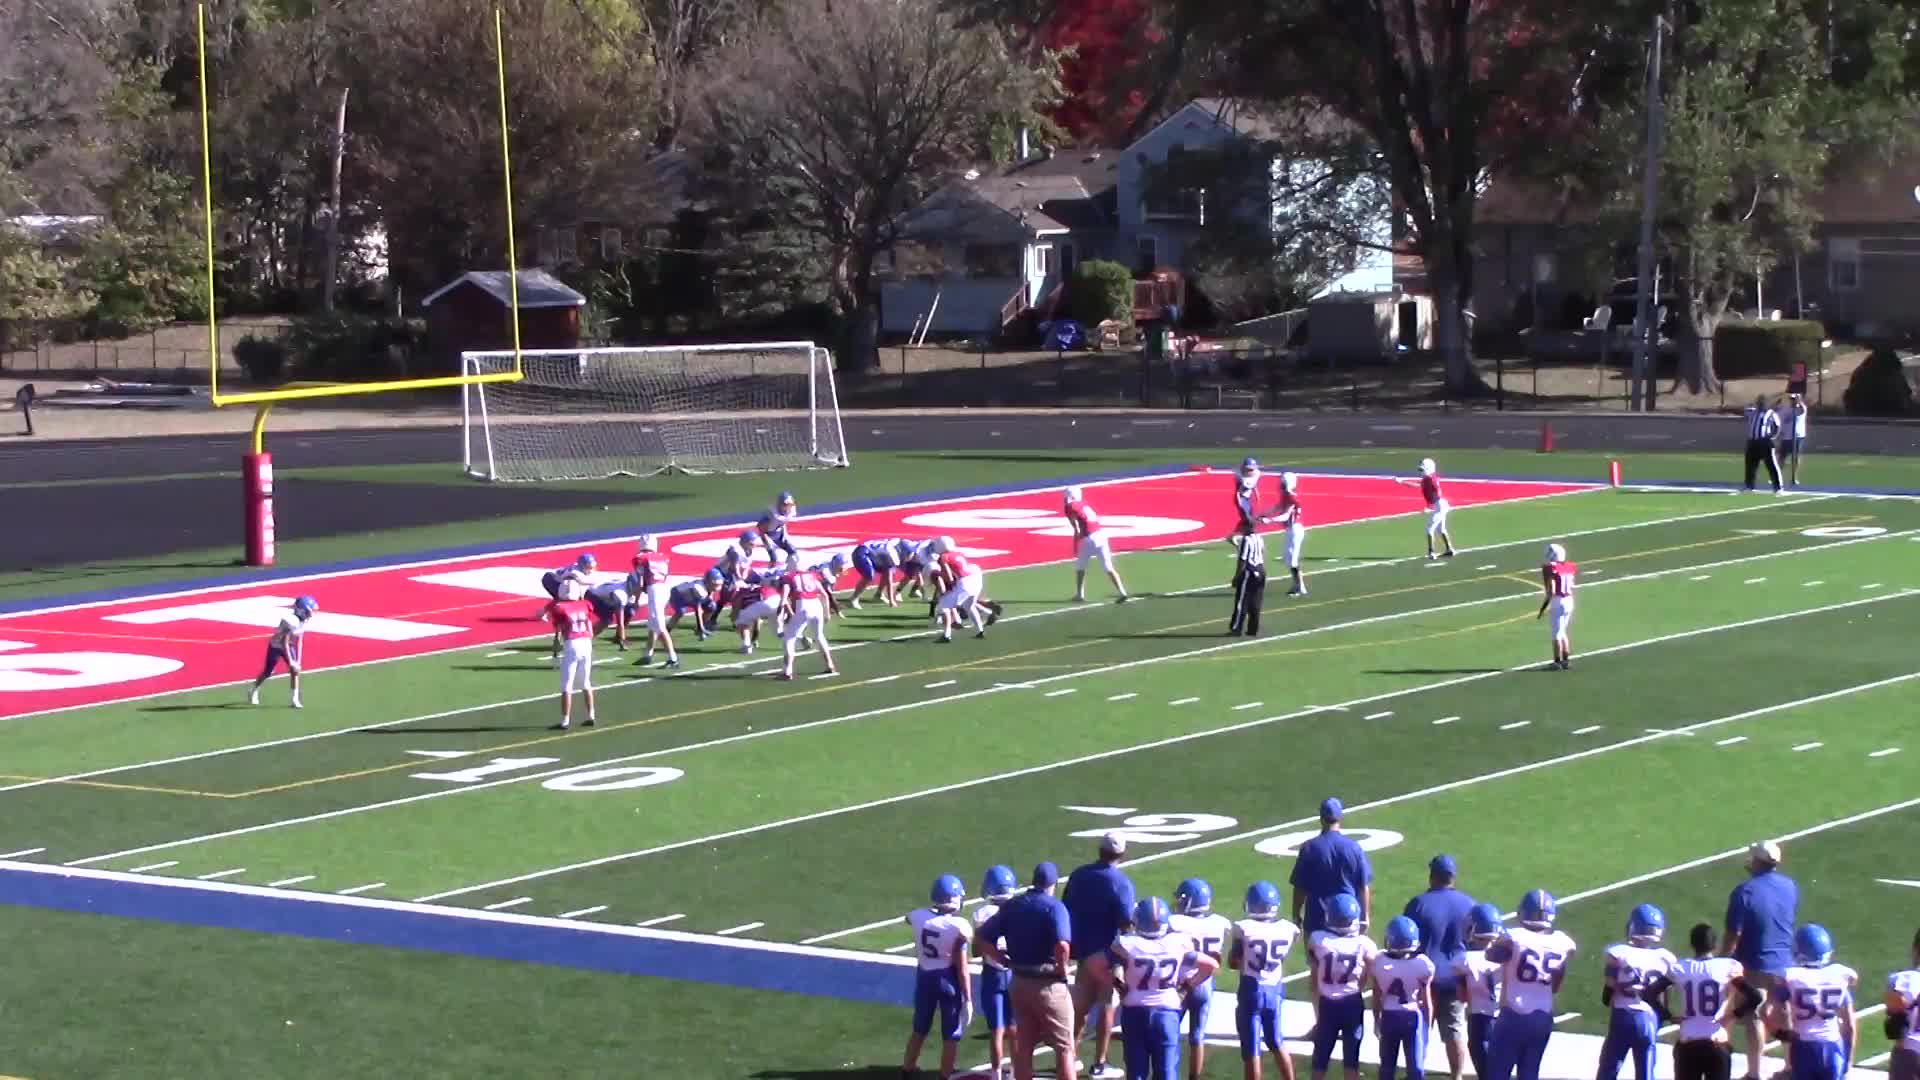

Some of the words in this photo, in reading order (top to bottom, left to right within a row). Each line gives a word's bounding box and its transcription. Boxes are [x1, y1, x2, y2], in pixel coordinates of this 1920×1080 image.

[407, 756, 685, 792] 10
[921, 928, 940, 959] 5
[1247, 939, 1289, 974] 35
[1134, 958, 1178, 990] 72
[1322, 952, 1358, 985] 17
[1516, 948, 1562, 987] 65
[1387, 976, 1408, 1005] 4
[1684, 979, 1720, 1017] 18
[1794, 988, 1842, 1020] 55
